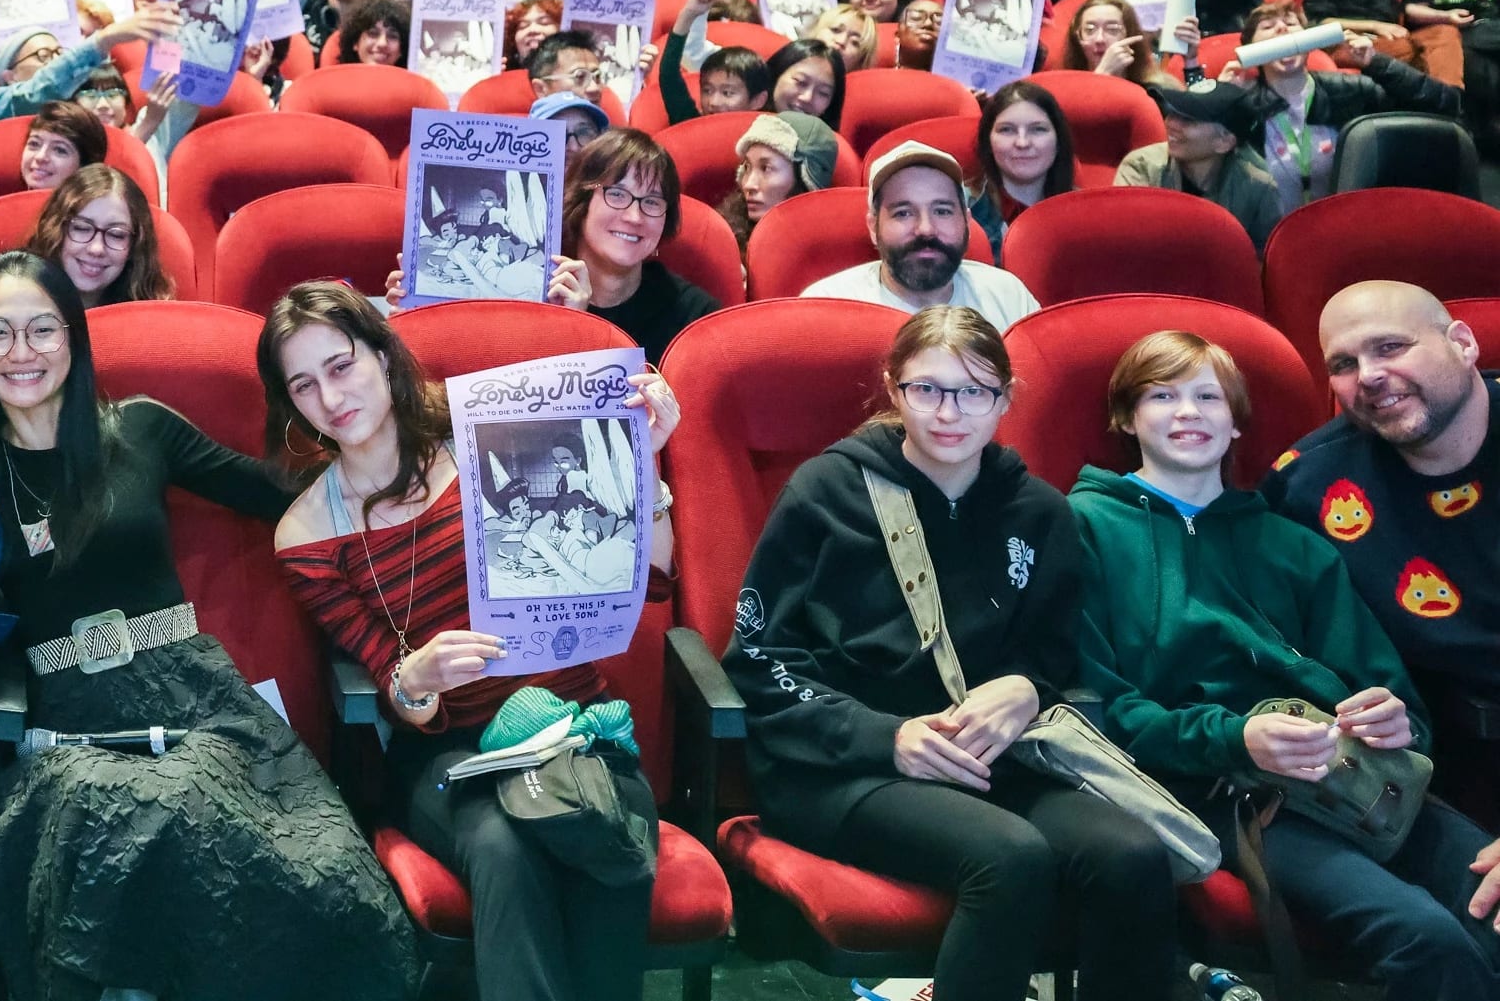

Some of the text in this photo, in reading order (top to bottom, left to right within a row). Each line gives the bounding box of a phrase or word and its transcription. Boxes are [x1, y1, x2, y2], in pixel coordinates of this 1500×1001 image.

[421, 122, 551, 164] Lonely Magic
[464, 364, 629, 412] Lonely Magic
[533, 610, 599, 623] A LOVE SONG
[546, 603, 567, 611] YES,
[572, 602, 593, 610] THIS
[597, 600, 605, 608] IS
